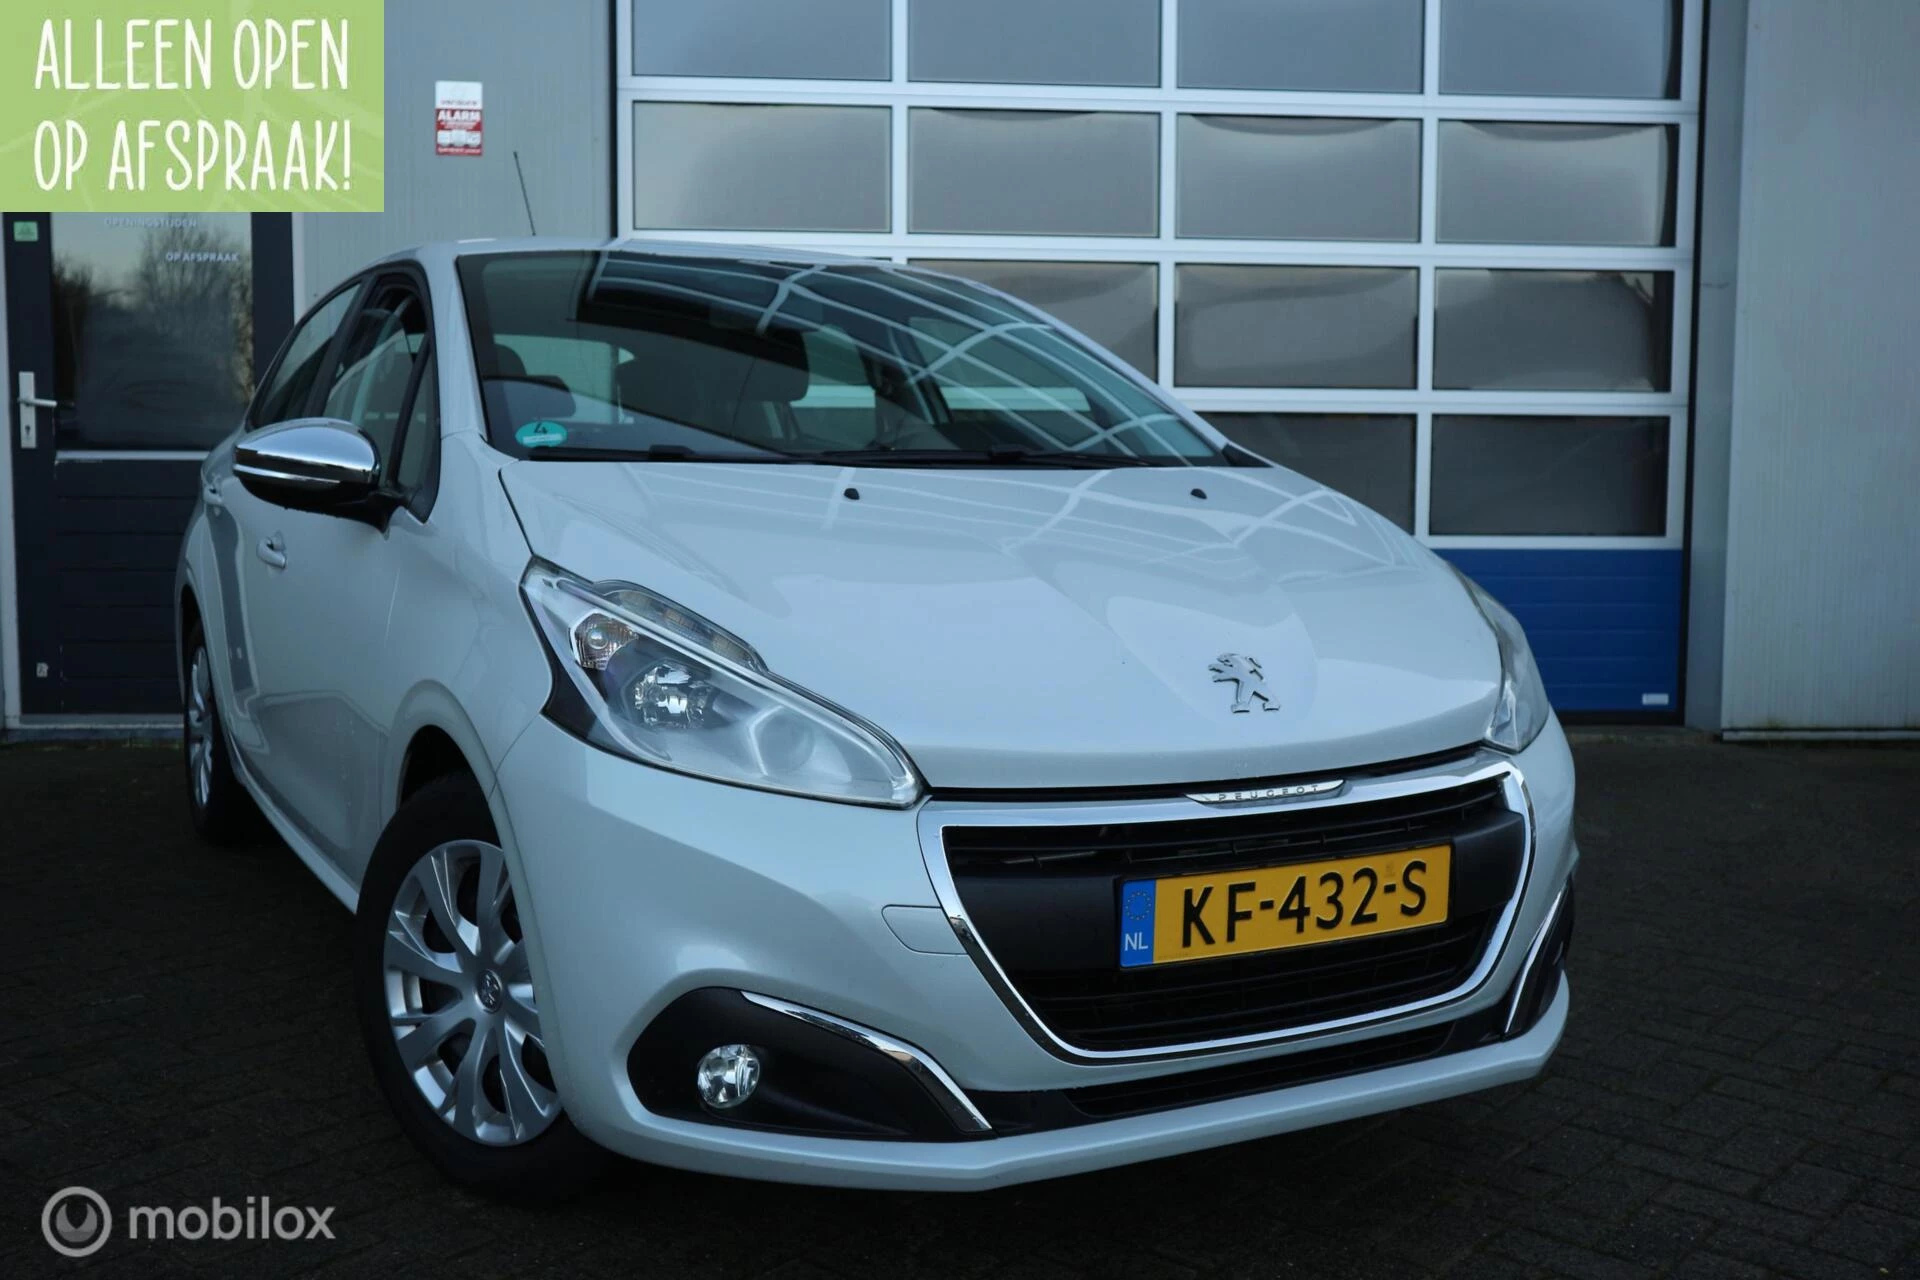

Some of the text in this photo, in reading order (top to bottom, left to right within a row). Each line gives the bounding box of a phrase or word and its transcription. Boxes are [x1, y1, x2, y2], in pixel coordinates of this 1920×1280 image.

[437, 109, 481, 121] ALARM
[165, 251, 181, 262] OP
[1218, 784, 1319, 801] PEUGEOT
[1182, 860, 1427, 948] KF-432-S
[1124, 931, 1149, 952] NL
